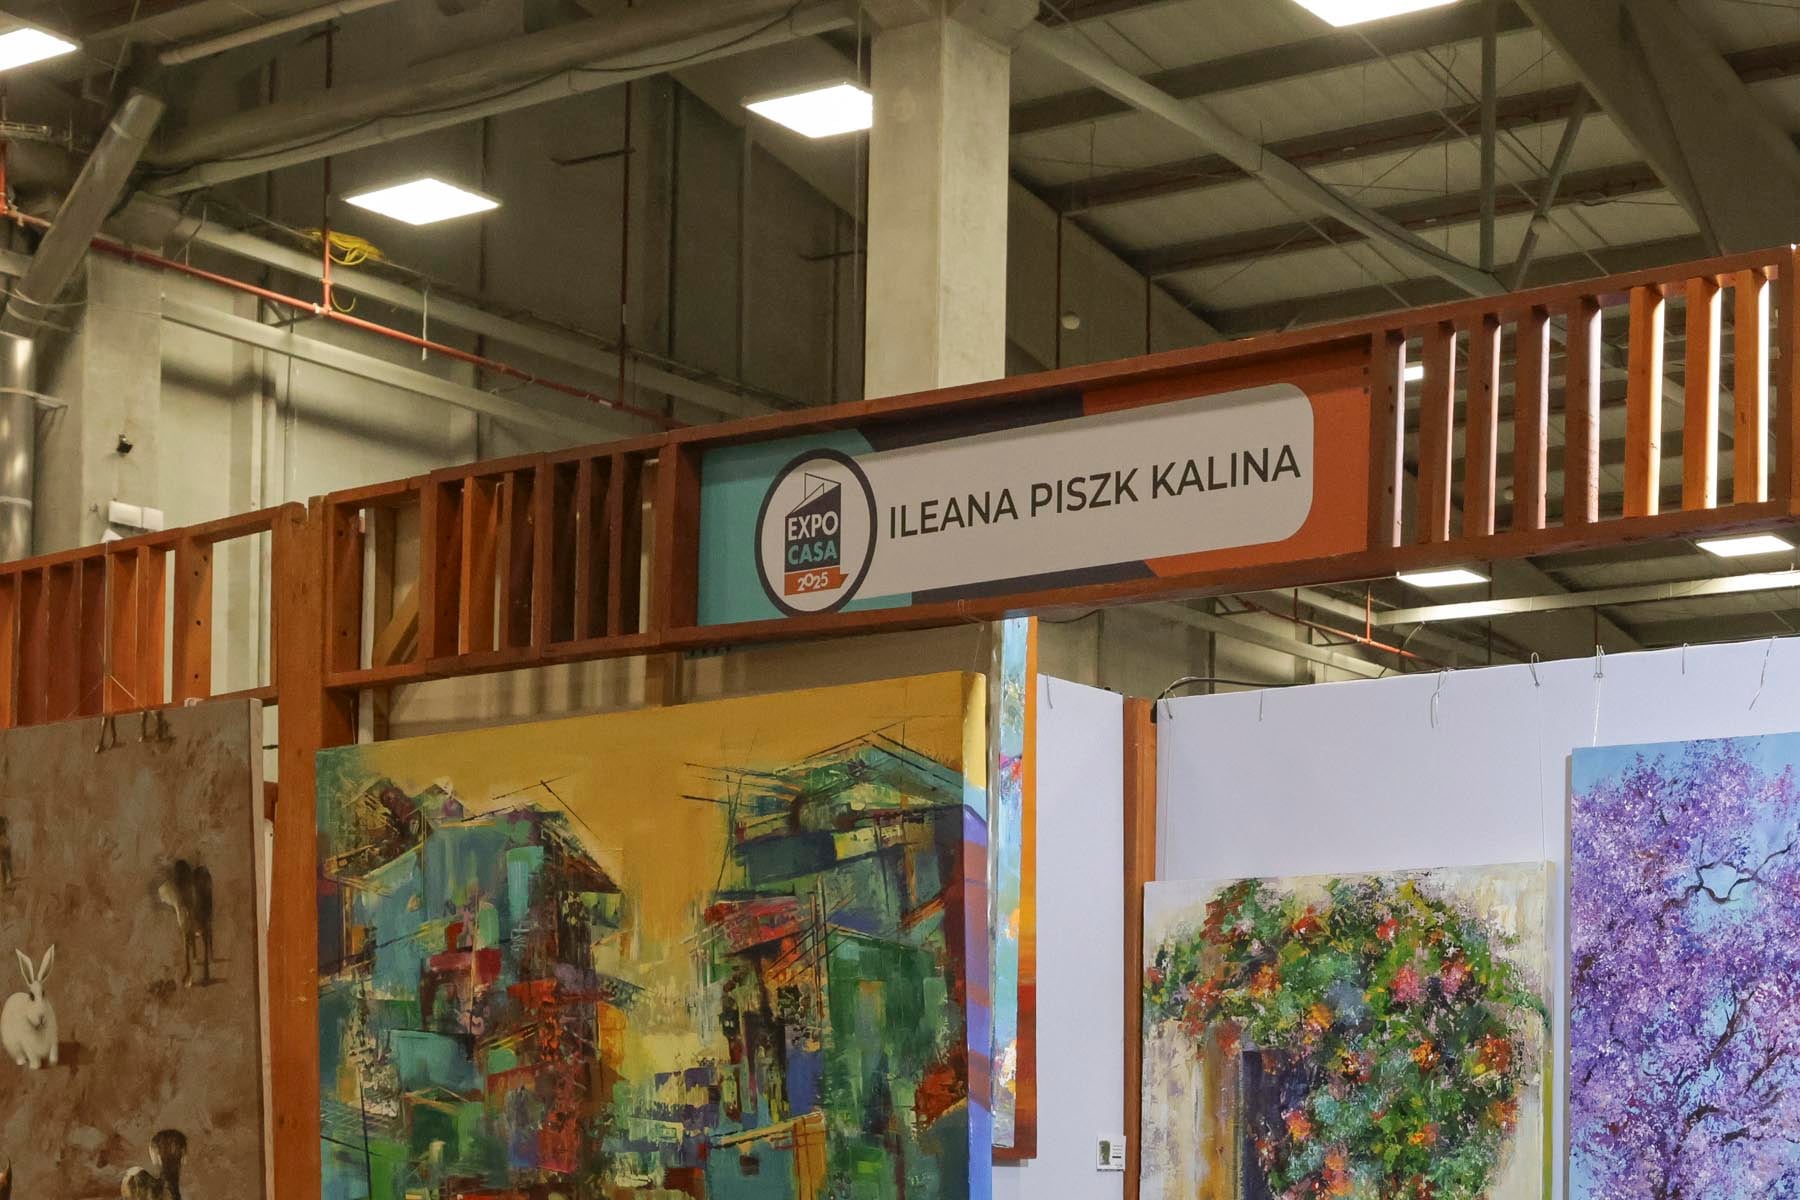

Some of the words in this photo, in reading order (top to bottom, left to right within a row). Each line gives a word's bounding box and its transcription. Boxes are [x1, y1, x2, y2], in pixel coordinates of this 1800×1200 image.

[890, 488, 1019, 539] ILEANA
[1030, 468, 1139, 518] PISZK
[1151, 444, 1302, 499] KALINA
[788, 510, 839, 541] EXPO
[788, 540, 837, 565] CASA
[797, 571, 829, 592] 2025
